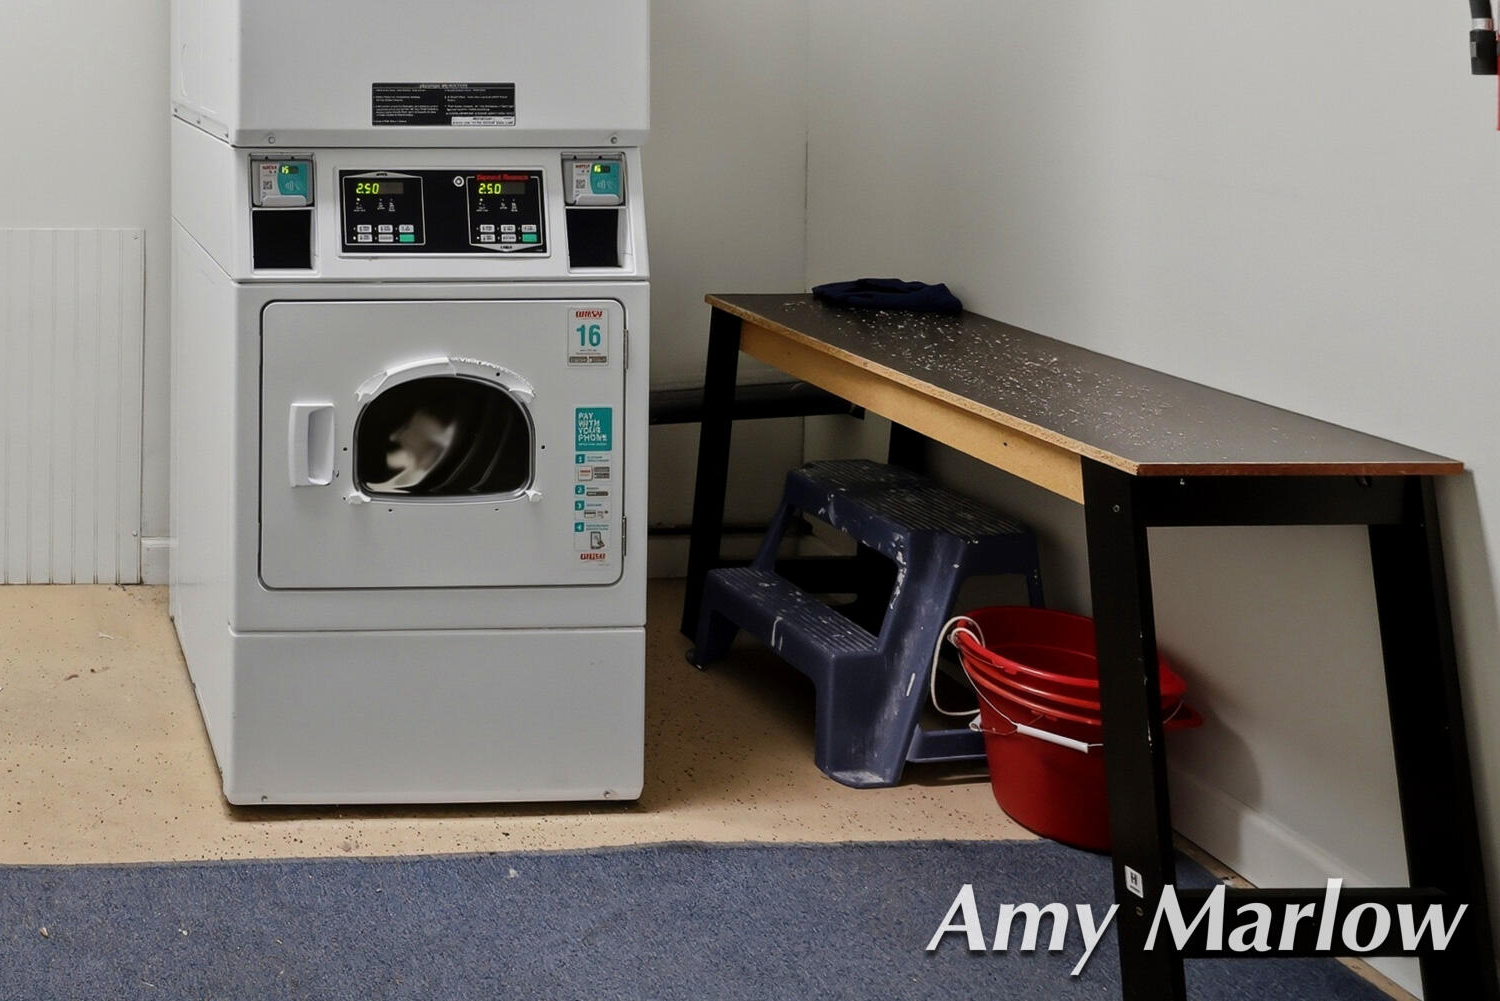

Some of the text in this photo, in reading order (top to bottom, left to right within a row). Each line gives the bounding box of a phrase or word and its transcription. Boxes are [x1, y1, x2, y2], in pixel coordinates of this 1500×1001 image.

[355, 182, 380, 195] 2.50
[478, 182, 502, 195] 2.50
[576, 323, 602, 347] 16
[578, 412, 594, 420] PAY
[578, 419, 601, 428] WITH
[578, 427, 601, 435] YOUR
[578, 434, 608, 442] PHONE
